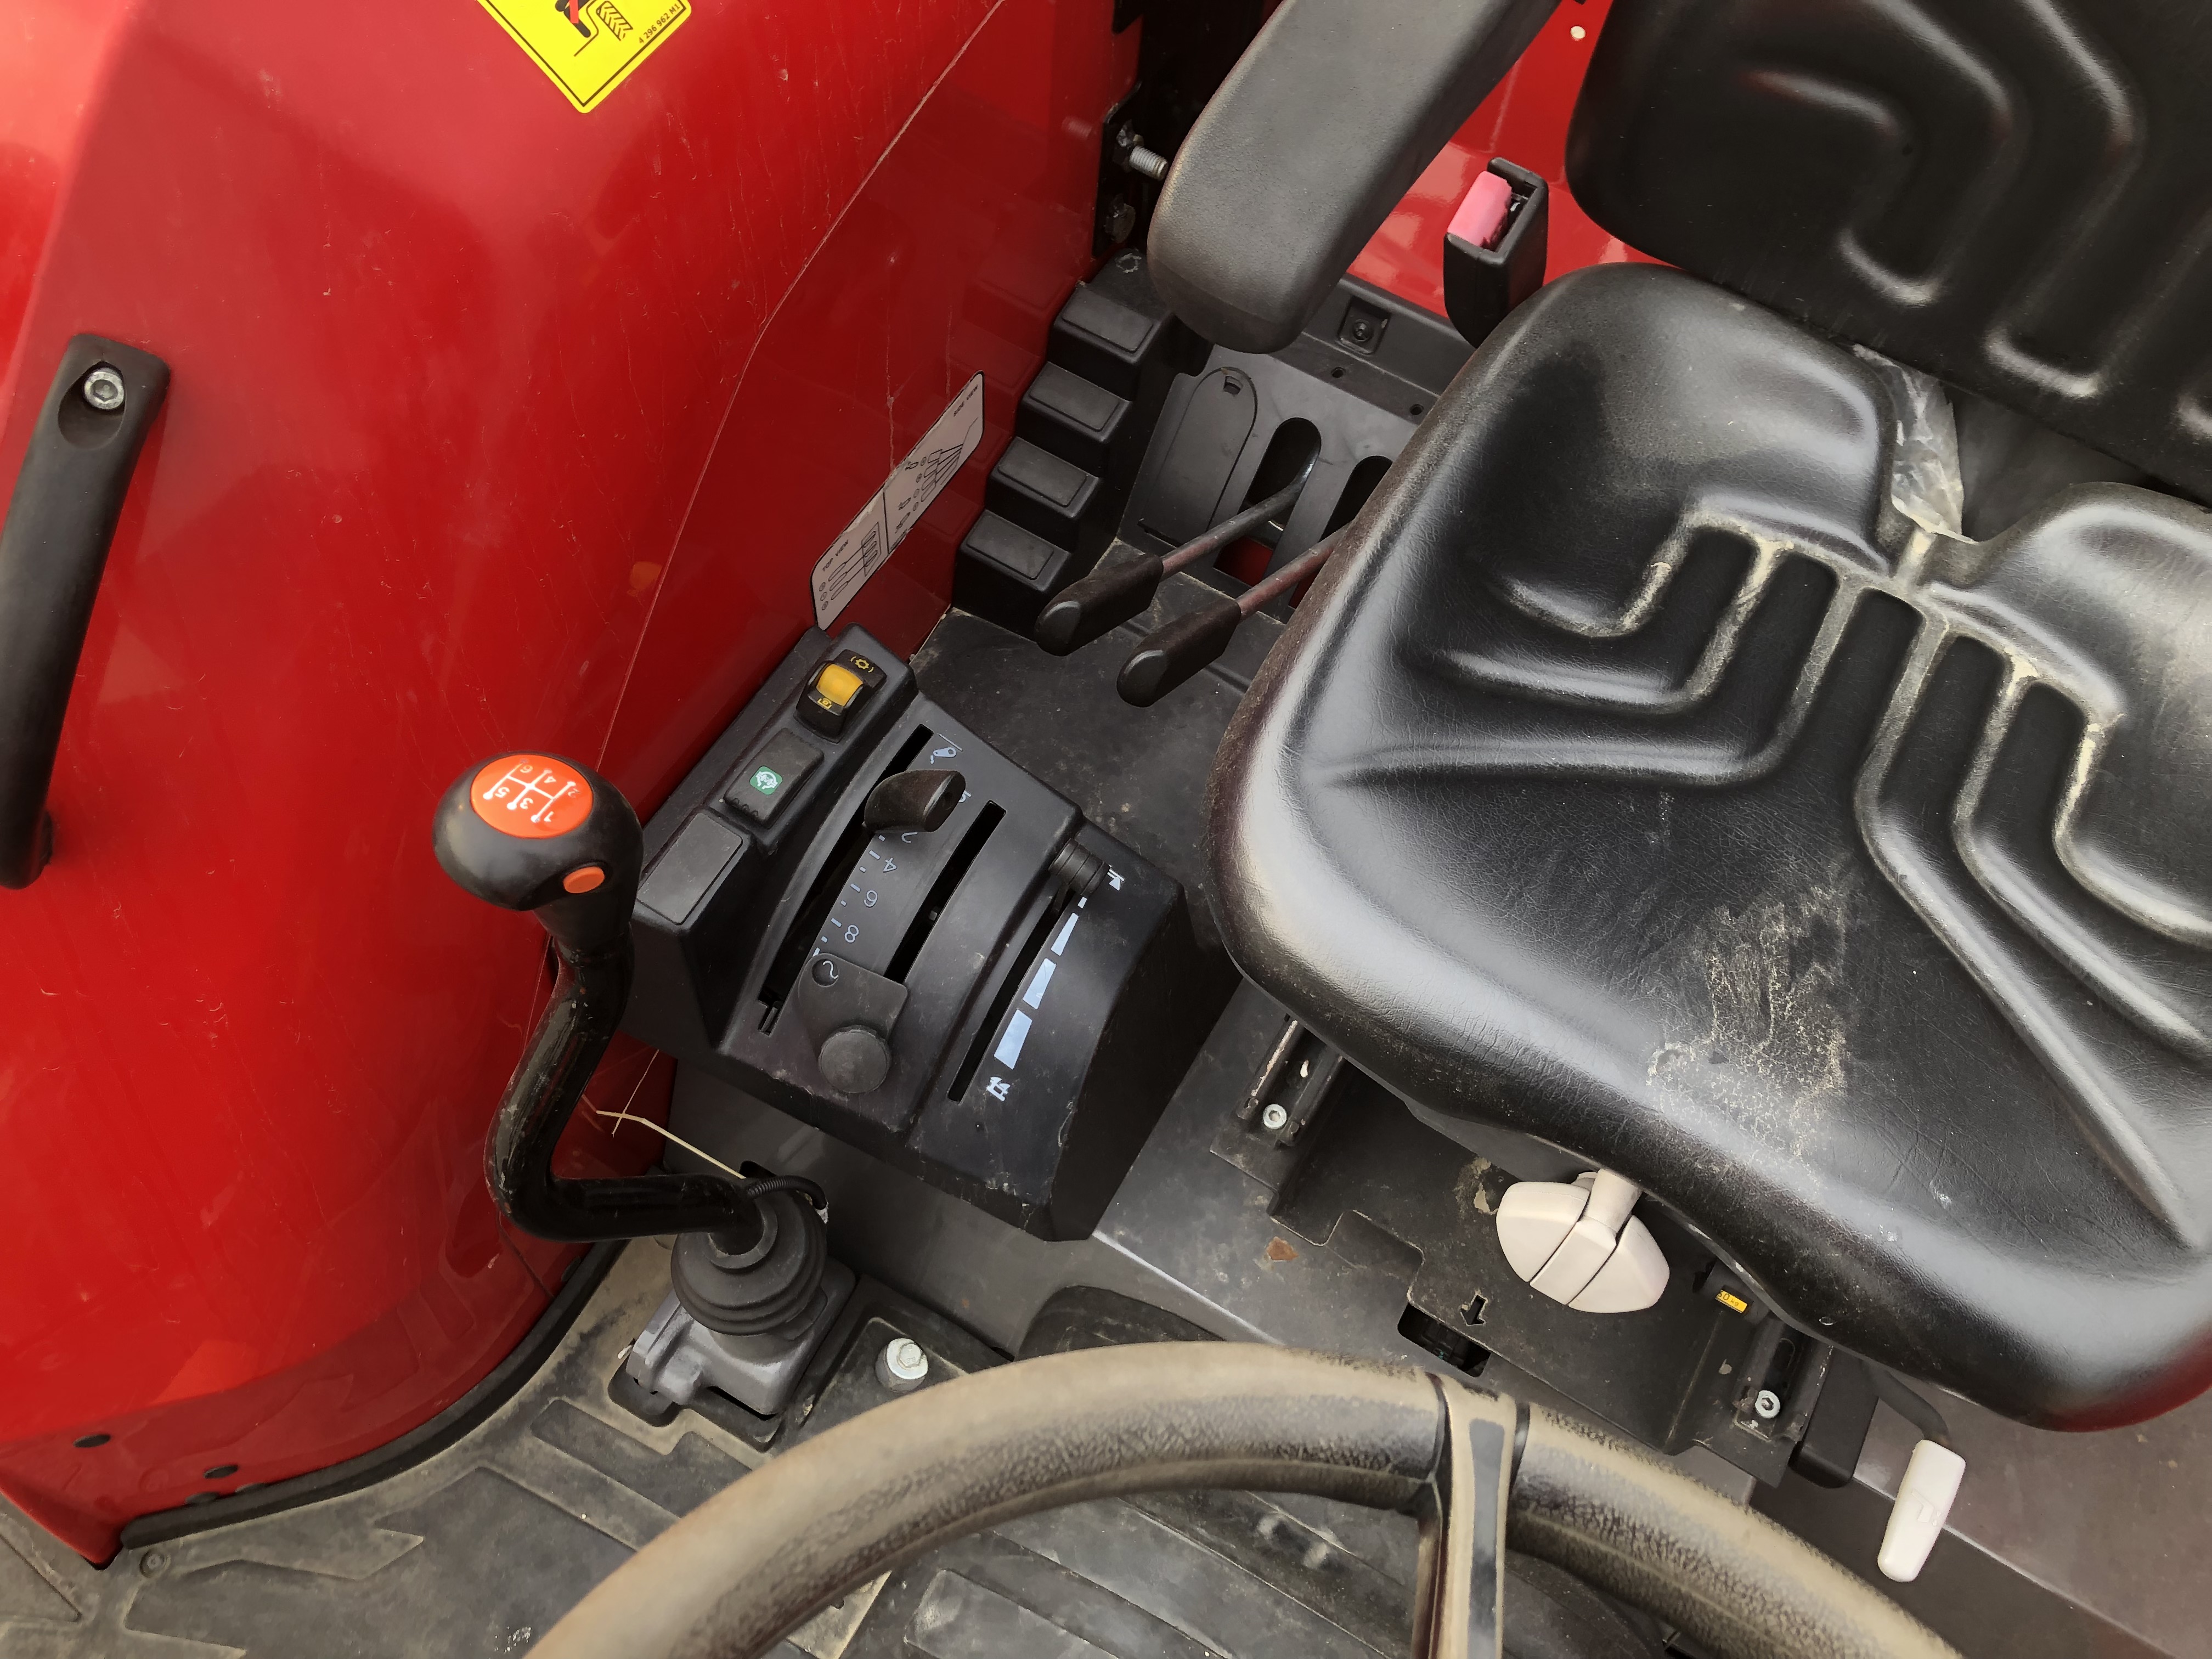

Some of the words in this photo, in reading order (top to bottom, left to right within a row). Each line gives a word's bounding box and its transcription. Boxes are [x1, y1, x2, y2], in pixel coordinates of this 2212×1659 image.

[643, 25, 657, 39] 296
[656, 13, 670, 26] 962
[669, 3, 680, 14] M1
[953, 401, 964, 416] SIDE
[967, 384, 978, 400] VIEW
[822, 558, 833, 572] TOP
[835, 539, 848, 556] VIEW
[495, 787, 510, 798] 5
[568, 788, 579, 798] 2
[520, 798, 533, 809] 3
[543, 811, 554, 822] 1
[883, 857, 898, 872] 4
[864, 890, 878, 907] 6
[844, 924, 859, 943] 8
